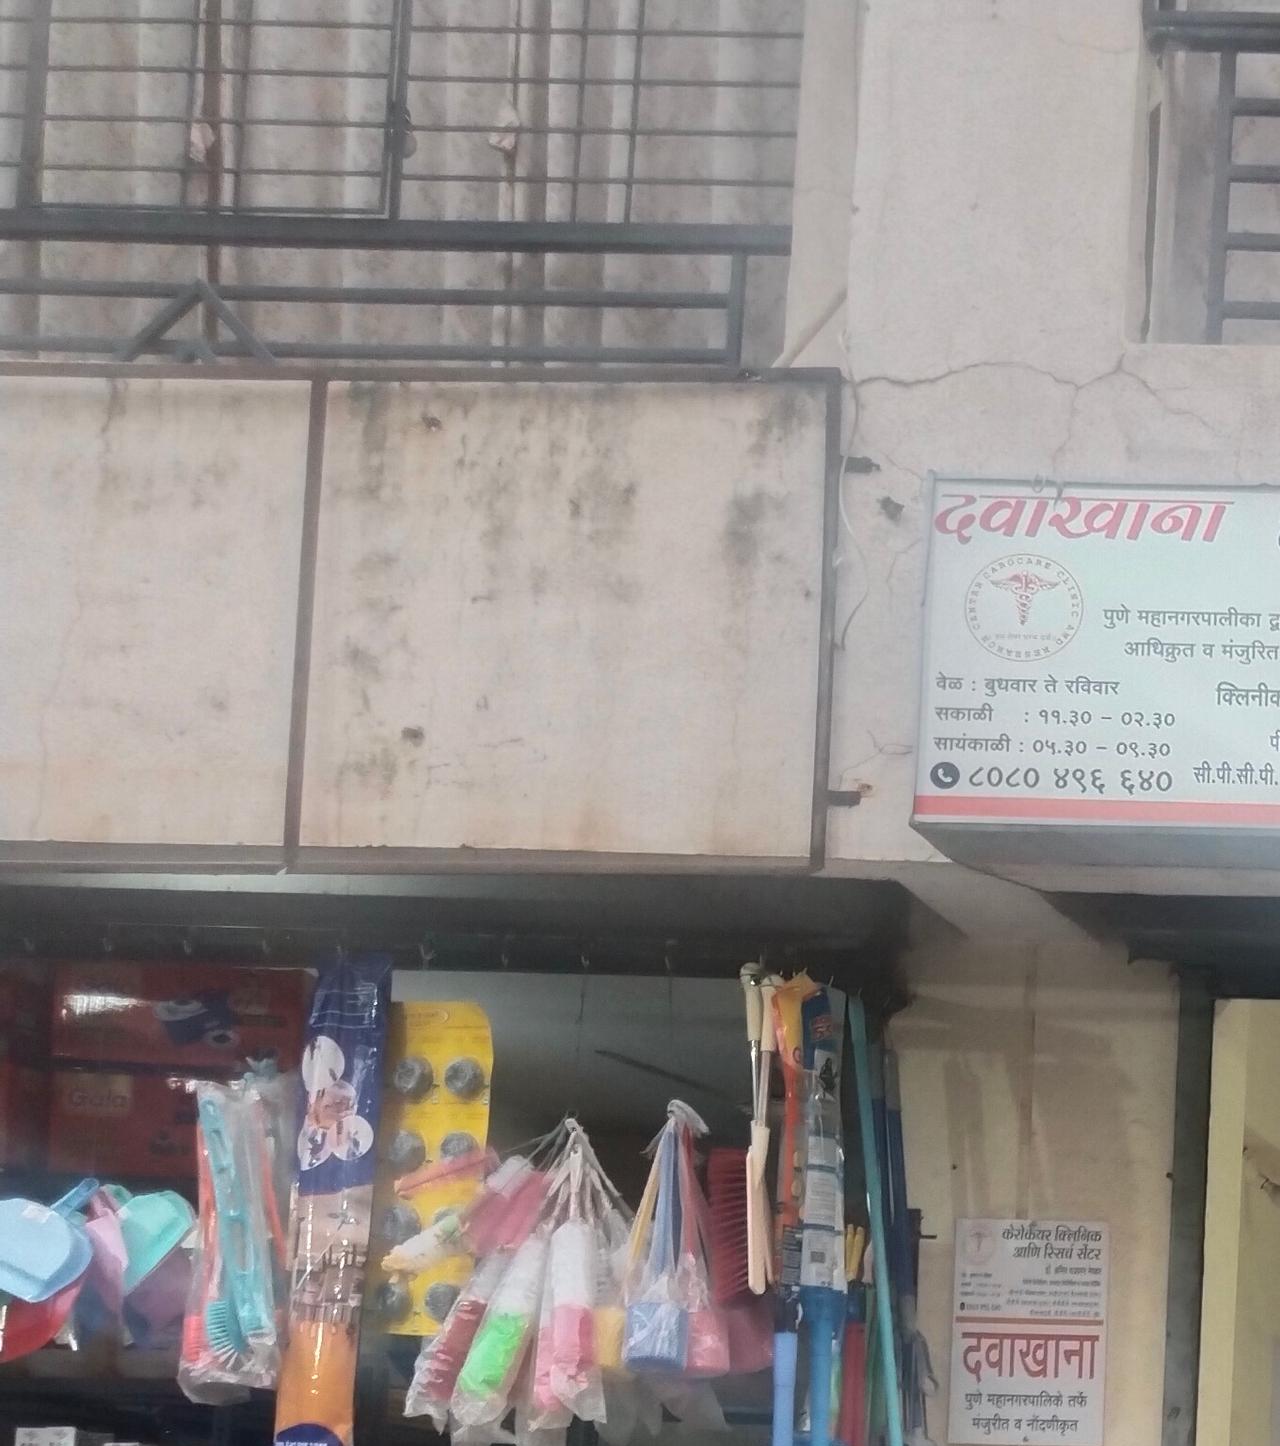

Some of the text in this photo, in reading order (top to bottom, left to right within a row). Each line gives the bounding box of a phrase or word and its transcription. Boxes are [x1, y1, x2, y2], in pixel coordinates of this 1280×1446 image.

[934, 493, 1234, 545] दवाखाना
[1103, 604, 1131, 628] पुणे
[1138, 607, 1262, 628] महानगरपालीका
[1203, 639, 1279, 664] व मंजुरित
[936, 672, 1120, 697] वेळ बुधवार ते रविवार
[935, 703, 993, 722] सकाळी
[1121, 712, 1175, 729] ०२.३०
[933, 733, 1011, 752] सायंकाळी
[1116, 741, 1170, 759] ०९.३०
[968, 766, 1173, 795] ८०८० ४९६ ६४०
[961, 1332, 1100, 1383] दवाखाना
[965, 1389, 982, 1410] पुणे
